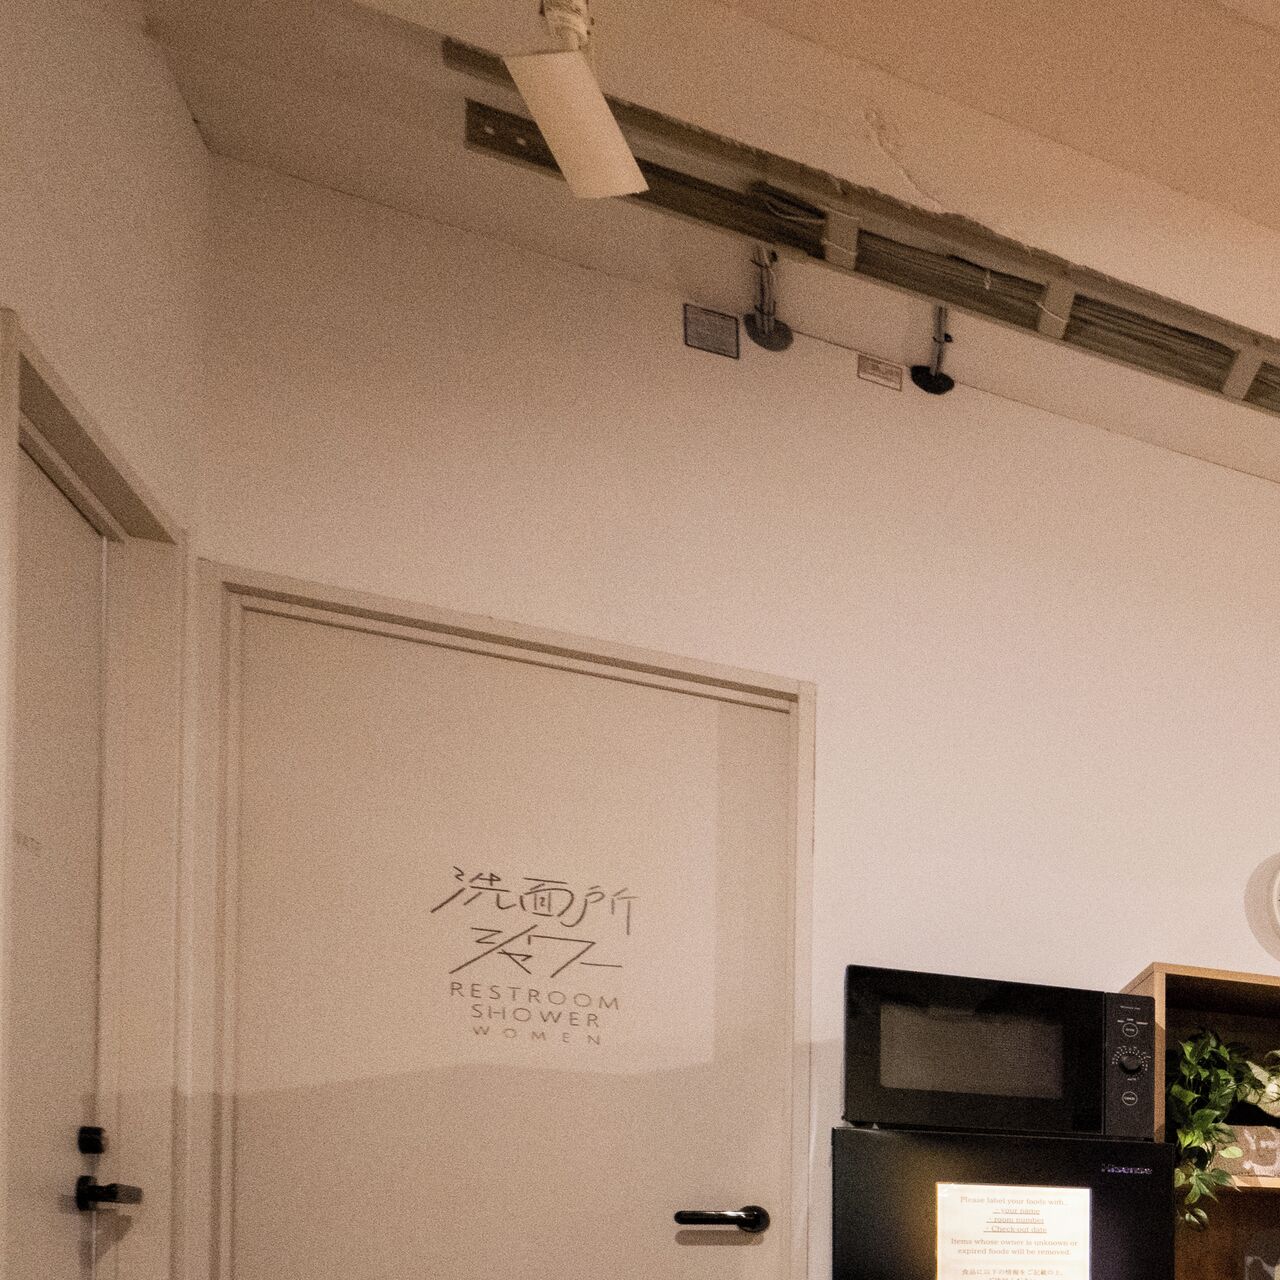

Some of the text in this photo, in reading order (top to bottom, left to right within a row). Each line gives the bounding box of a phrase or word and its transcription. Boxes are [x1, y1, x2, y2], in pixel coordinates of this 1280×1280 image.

[430, 866, 640, 935] 洗面所
[449, 924, 623, 978] シャワー
[450, 982, 619, 1010] RESTROOM
[471, 1004, 600, 1028] SHOWER
[472, 1026, 600, 1045] WOMEN
[960, 1196, 985, 1204] Please
[987, 1196, 1005, 1204] label
[1007, 1198, 1024, 1206] your
[958, 1248, 987, 1256] expired
